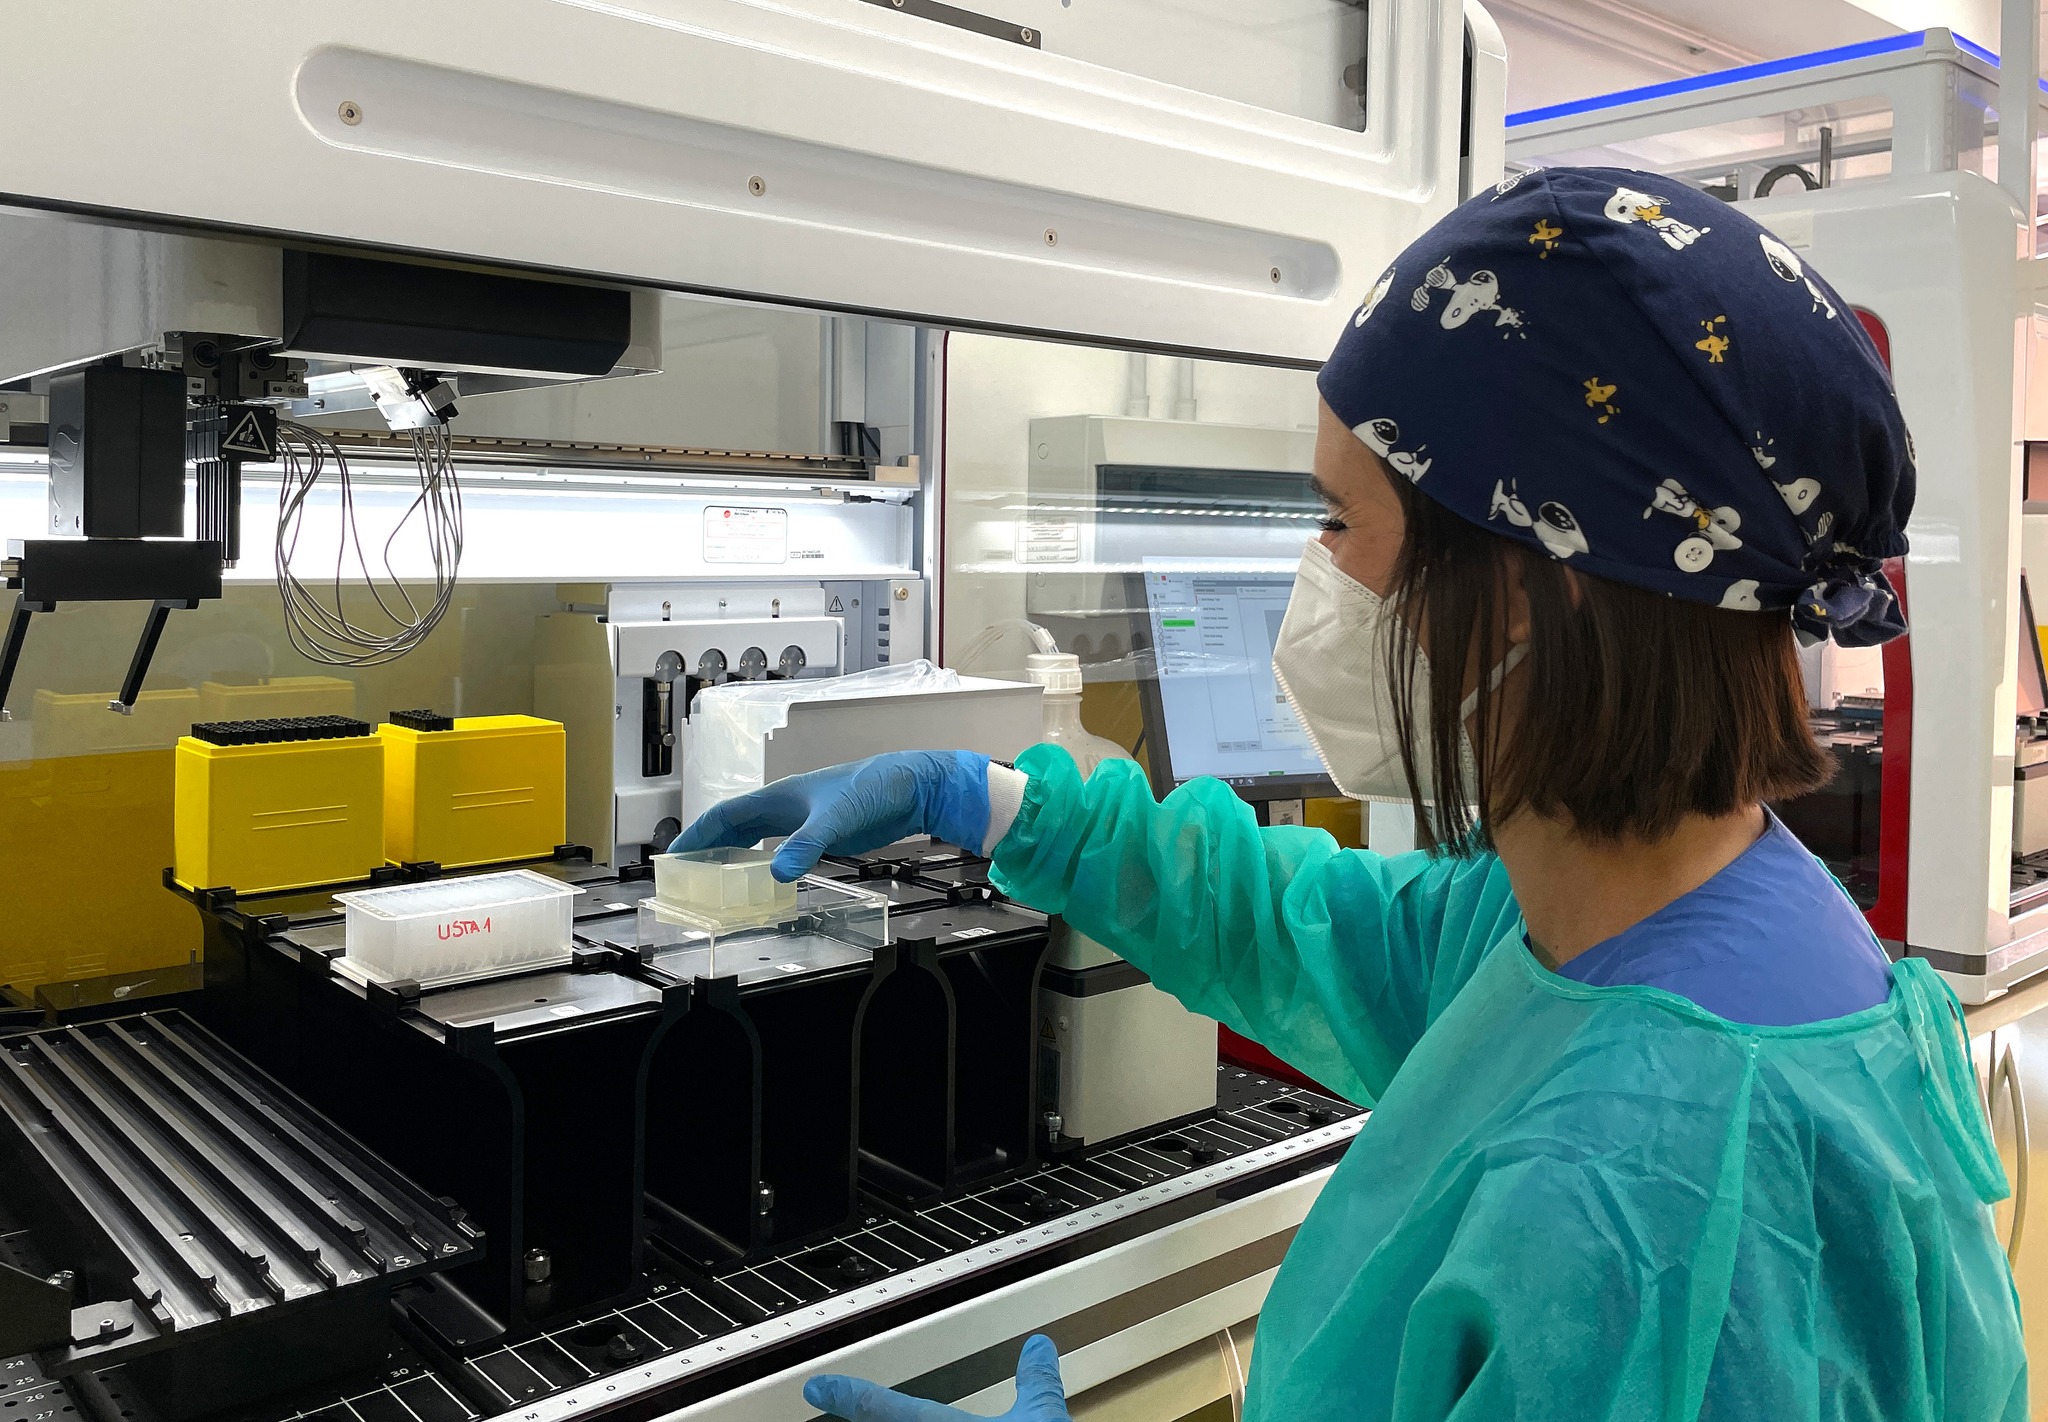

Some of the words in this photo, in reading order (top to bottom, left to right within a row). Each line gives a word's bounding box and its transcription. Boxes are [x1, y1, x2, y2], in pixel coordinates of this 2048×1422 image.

[437, 920, 480, 941] USTA
[483, 917, 492, 933] 1
[346, 1269, 363, 1280] 4
[393, 1255, 411, 1268] 5
[443, 1243, 458, 1253] 6
[5, 1360, 25, 1370] 24
[390, 1368, 409, 1378] 30
[15, 1376, 35, 1386] 25
[25, 1393, 45, 1403] 26
[525, 1412, 539, 1421] M
[566, 1398, 578, 1406] N
[606, 1384, 616, 1392] O
[35, 1410, 54, 1421] 27
